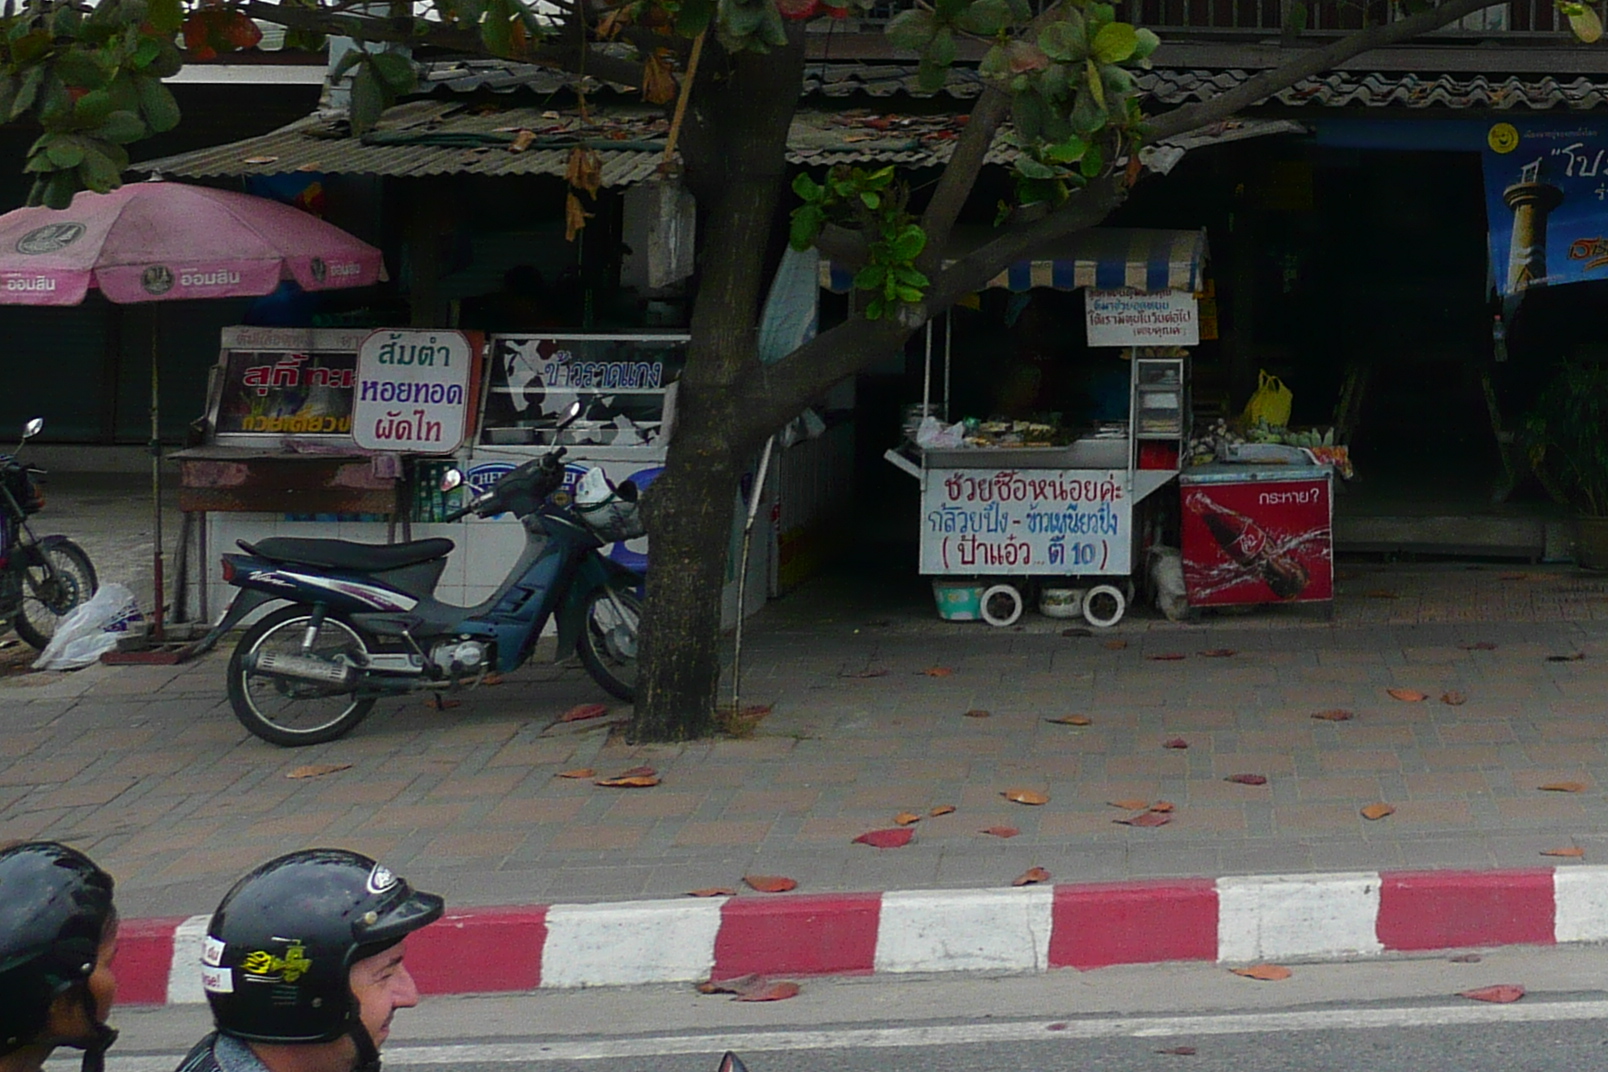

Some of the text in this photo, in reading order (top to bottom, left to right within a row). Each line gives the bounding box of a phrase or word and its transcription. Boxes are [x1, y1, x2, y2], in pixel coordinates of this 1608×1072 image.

[7, 275, 56, 293] ออมสิน
[180, 269, 241, 287] ออมสิน
[378, 333, 451, 366] ส้มตำ
[545, 349, 664, 388] ข้าวราดแกง
[360, 380, 463, 405] หอยทอด
[375, 410, 441, 442] ผัดไท
